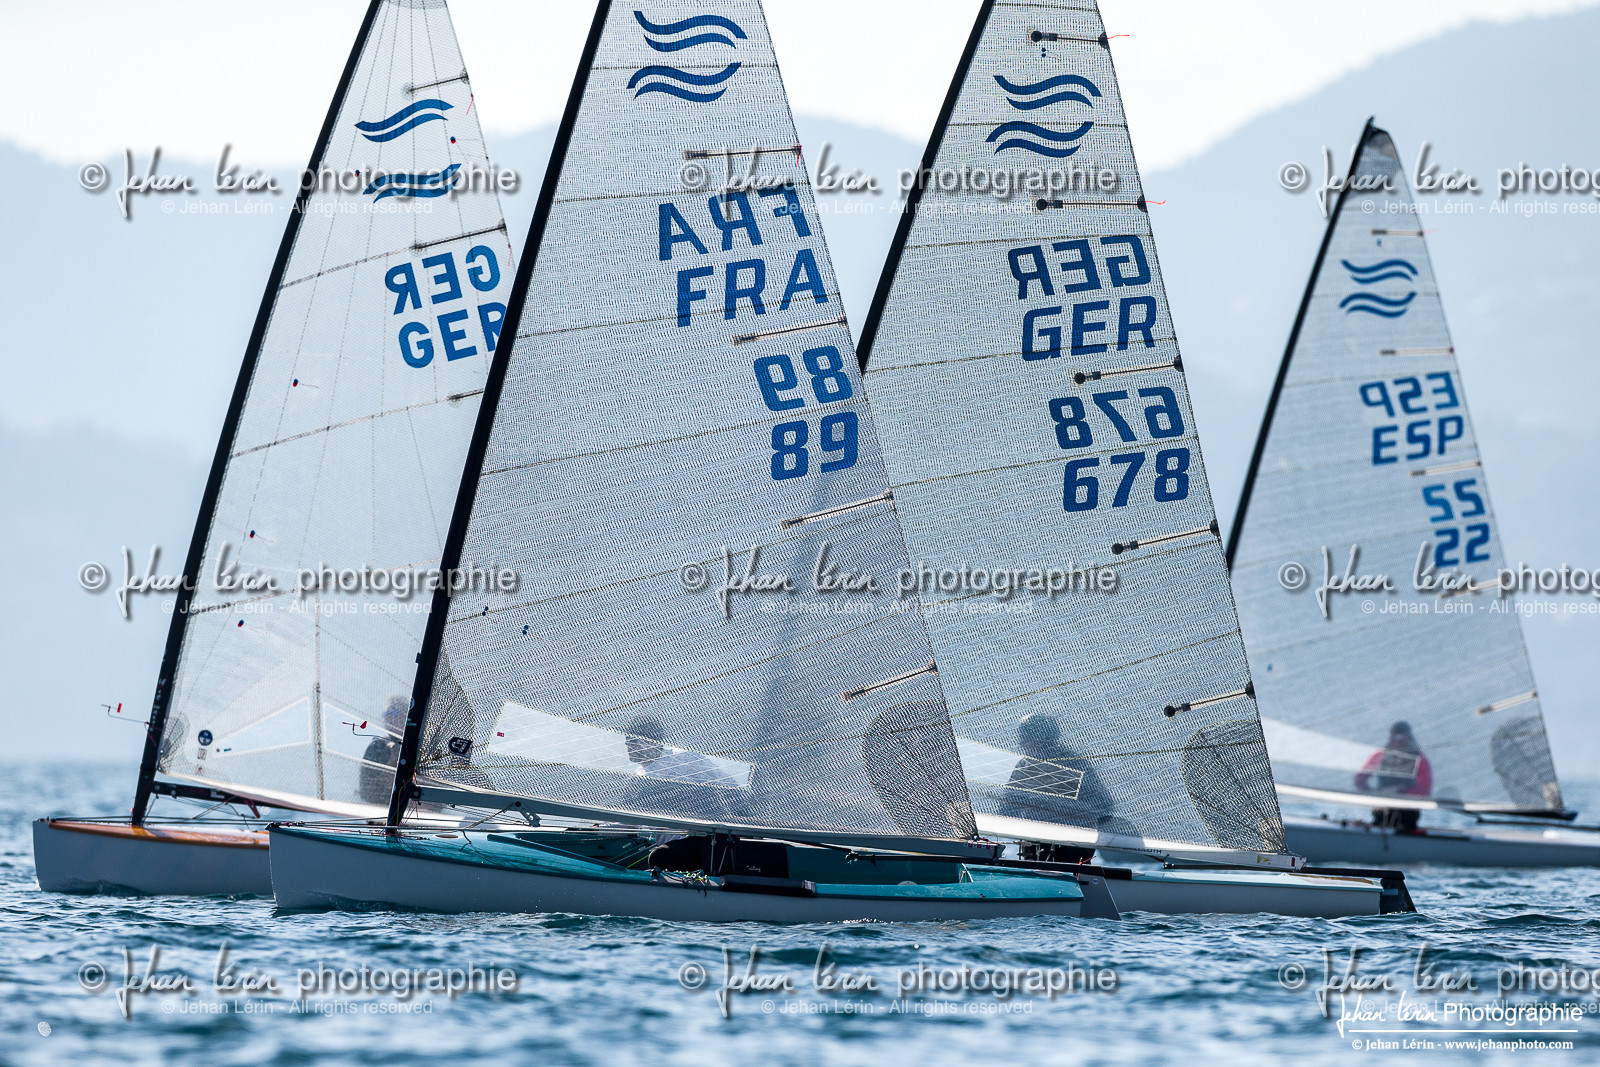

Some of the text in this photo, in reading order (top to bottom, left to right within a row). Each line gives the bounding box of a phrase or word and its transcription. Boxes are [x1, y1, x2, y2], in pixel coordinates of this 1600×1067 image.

[677, 249, 828, 327] FRA
[399, 302, 507, 368] GER
[1022, 296, 1157, 361] GER
[771, 411, 858, 480] 89
[1372, 415, 1463, 466] ESP
[1063, 448, 1190, 512] 678
[1435, 523, 1490, 567] 22
